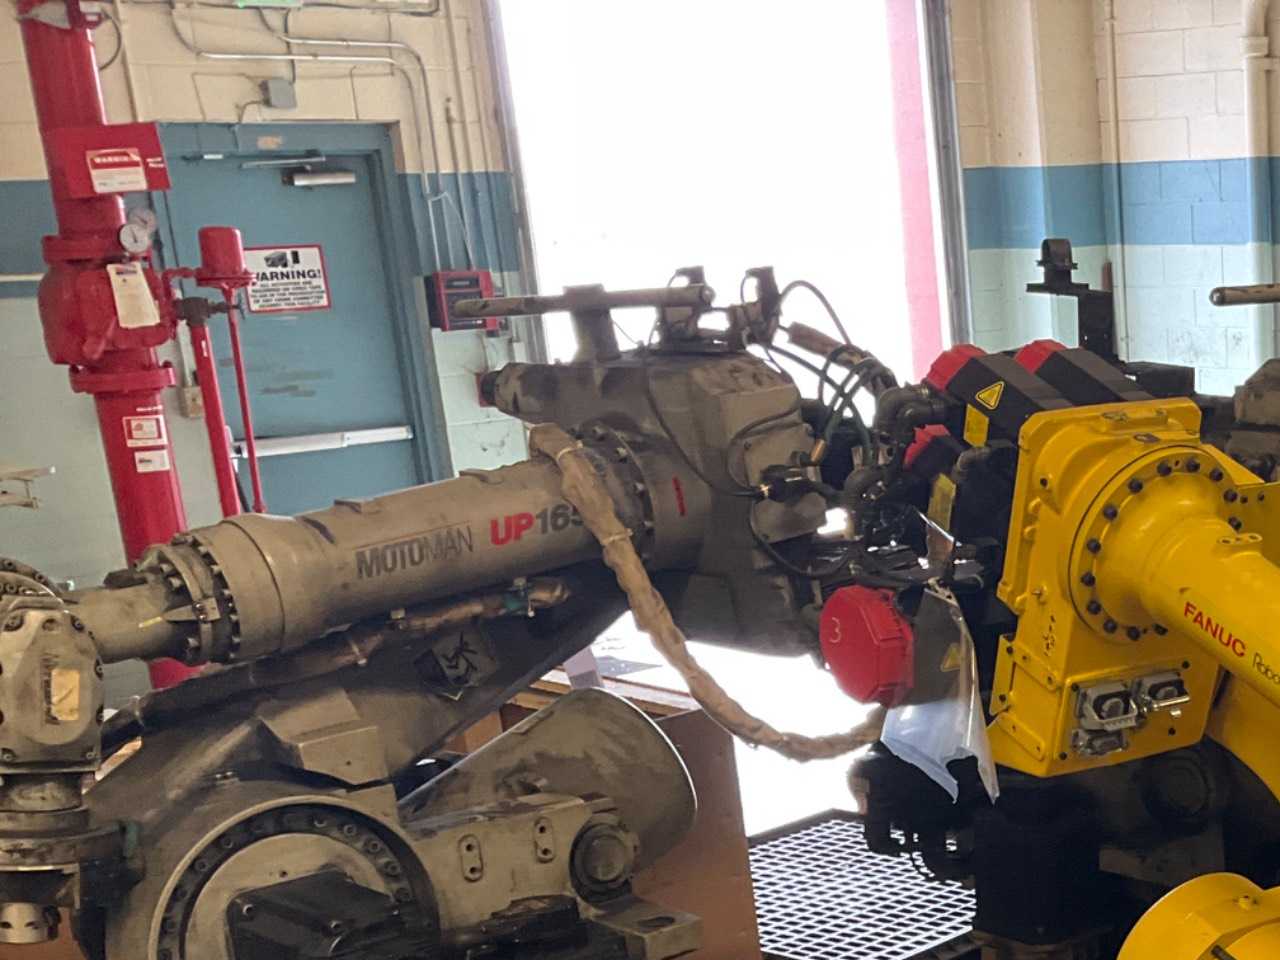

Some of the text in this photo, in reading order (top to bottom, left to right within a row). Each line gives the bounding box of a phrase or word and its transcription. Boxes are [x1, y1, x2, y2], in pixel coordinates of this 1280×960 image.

[354, 526, 474, 580] MOTOMAN
[829, 616, 842, 643] 3
[1183, 601, 1246, 657] FANUC
